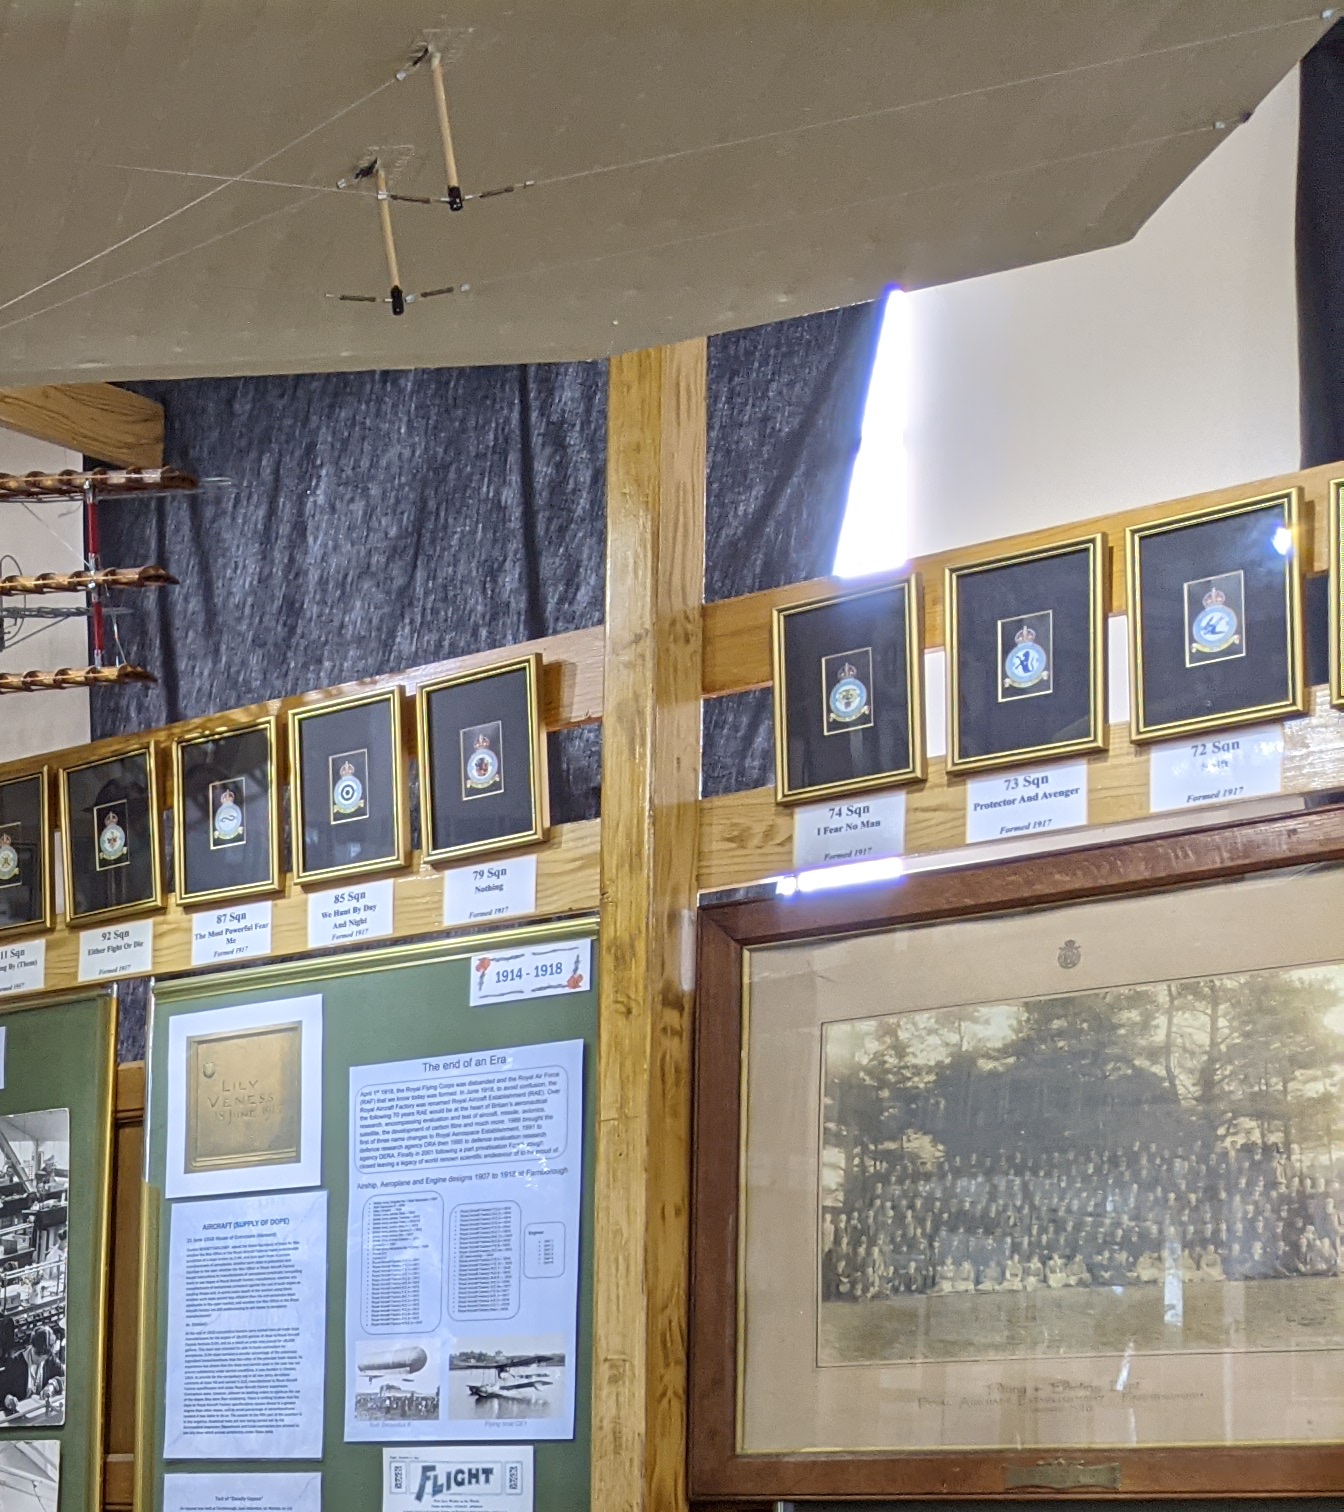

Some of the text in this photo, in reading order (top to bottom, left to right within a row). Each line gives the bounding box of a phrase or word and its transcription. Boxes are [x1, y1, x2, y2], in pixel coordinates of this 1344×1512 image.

[1191, 741, 1240, 757] 72 Sqn
[1004, 775, 1049, 791] 73 Sqn
[973, 788, 1080, 811] Protector And Avenger
[828, 805, 870, 819] 74 Sqn
[823, 826, 842, 835] Fear
[845, 823, 858, 832] No
[860, 820, 881, 829] Man
[473, 868, 507, 880] 79 Sqn
[474, 883, 504, 894] Nothing
[334, 892, 366, 904] 85 Sqn
[216, 913, 247, 924] 87 Sqn
[321, 904, 377, 919] We Hunt By Day
[332, 917, 368, 929] And Night
[101, 931, 130, 941] 92 Sqn
[195, 923, 269, 940] The Most Powerful Fear
[106, 944, 122, 954] Fight
[133, 941, 144, 949] Die
[495, 968, 522, 984] 1914
[534, 962, 563, 978] 1918
[423, 1055, 507, 1073] The end of an Era
[222, 1080, 258, 1092] LILY
[207, 1091, 274, 1109] VENESS
[414, 1465, 494, 1502] FLIGHT
